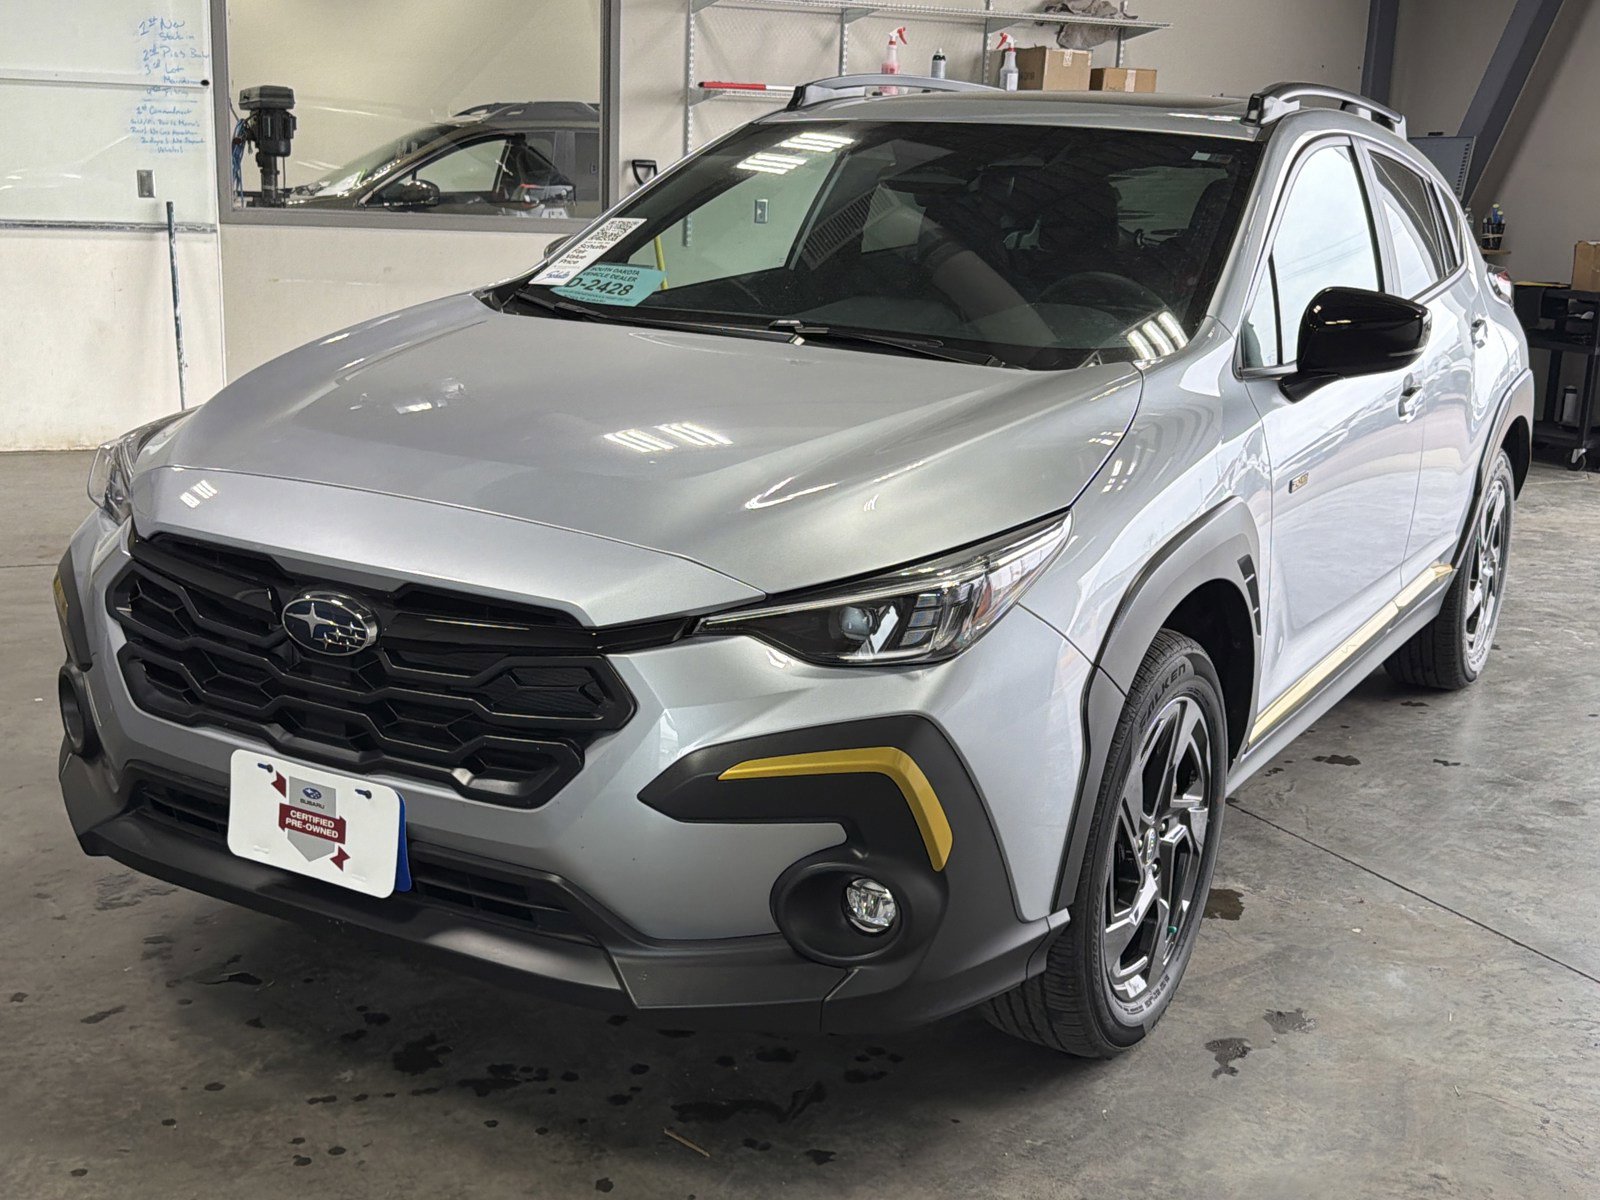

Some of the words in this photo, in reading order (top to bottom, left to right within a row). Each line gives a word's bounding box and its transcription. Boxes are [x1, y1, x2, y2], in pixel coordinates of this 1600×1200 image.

[583, 271, 610, 279] VEHICLE
[610, 273, 638, 282] DEALER
[613, 268, 640, 276] DAKOTA
[565, 277, 634, 296] D-2428
[300, 799, 325, 810] SUBARU
[290, 809, 335, 829] CERTIFIED
[285, 818, 339, 839] PRE-OWNED
